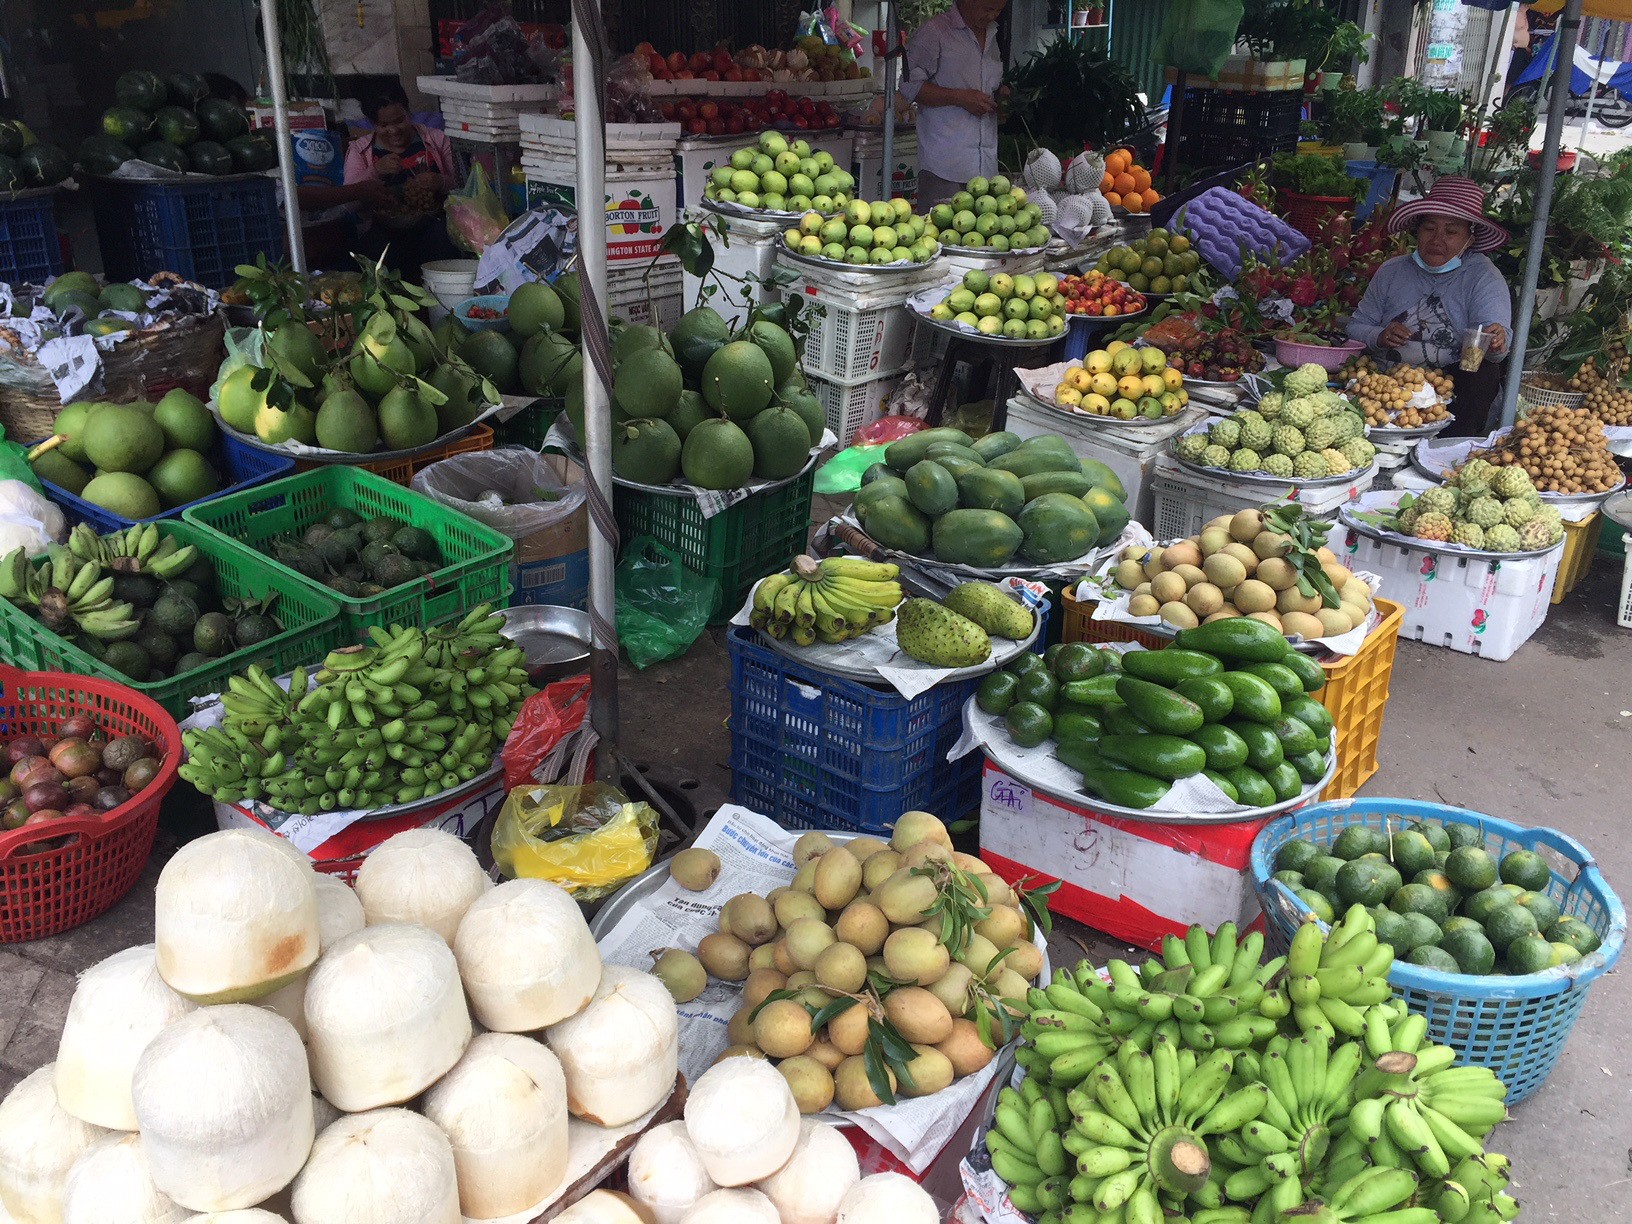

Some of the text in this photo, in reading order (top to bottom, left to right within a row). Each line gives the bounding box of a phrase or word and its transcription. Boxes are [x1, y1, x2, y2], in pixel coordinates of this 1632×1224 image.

[605, 209, 658, 222] BORTON FRUIT
[607, 246, 633, 257] INGTON
[634, 244, 652, 254] STATE
